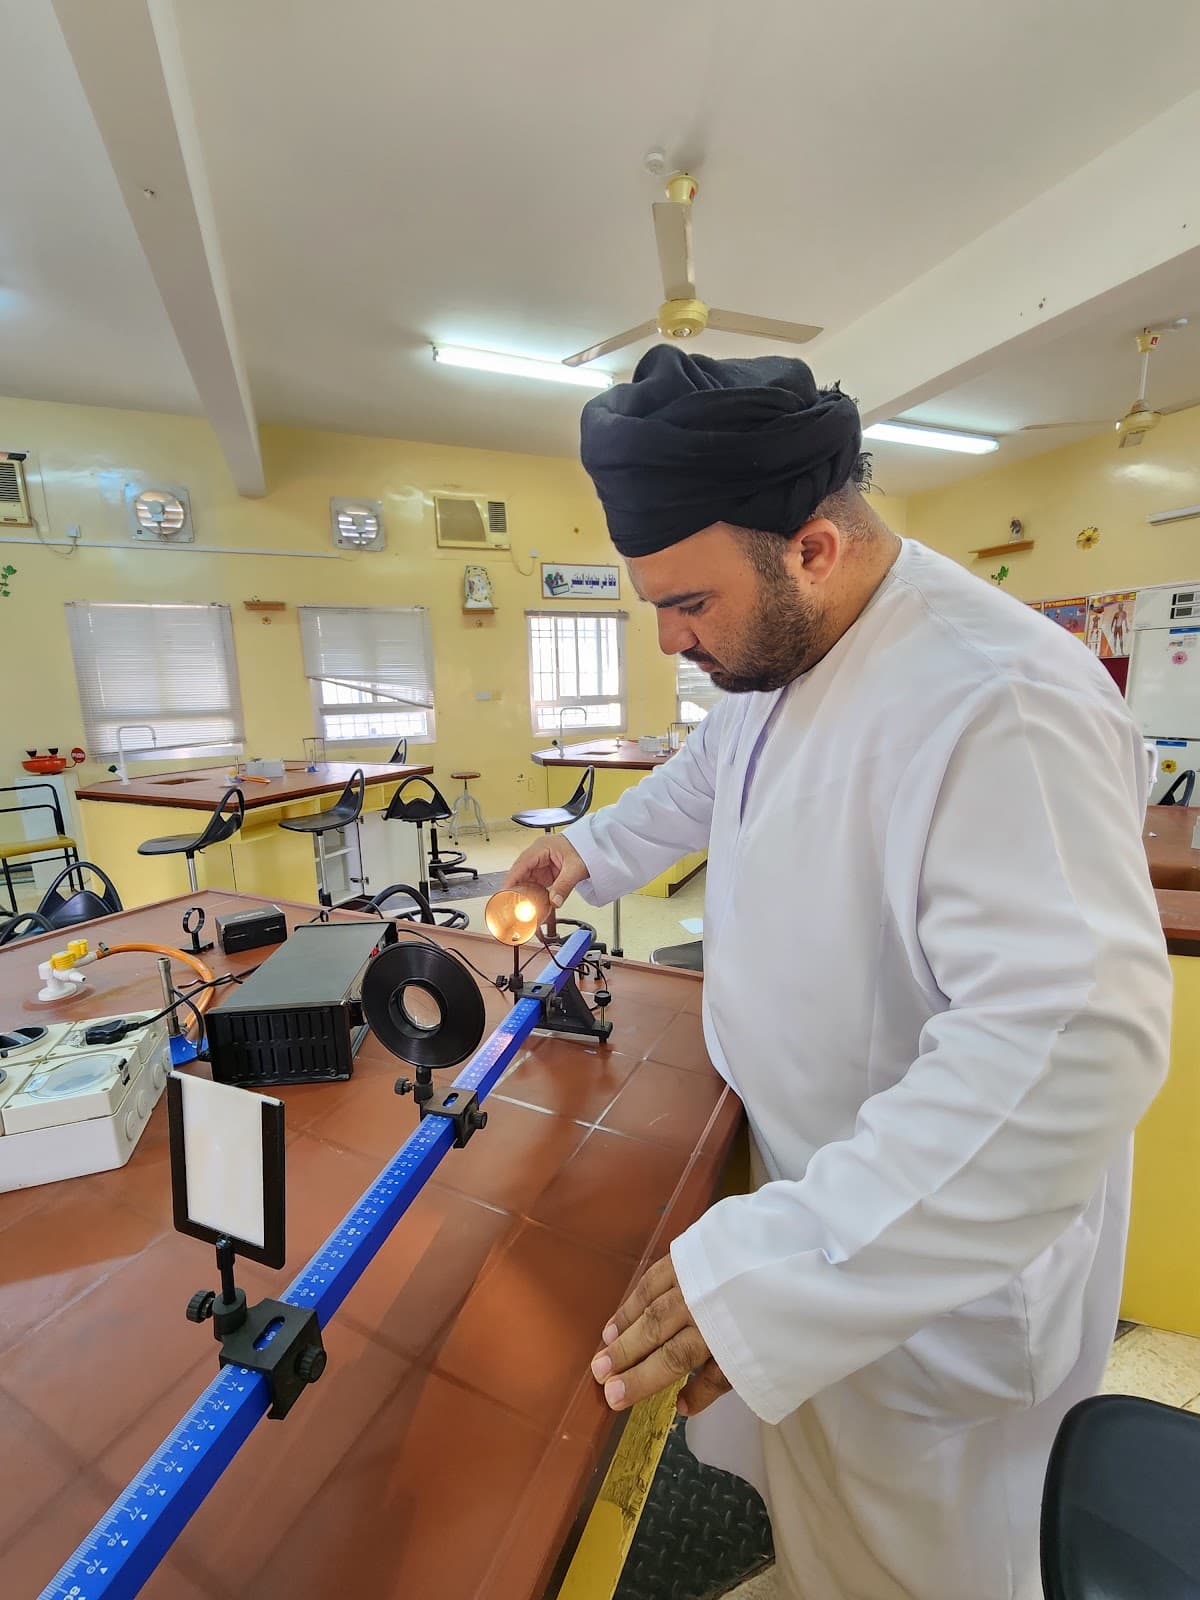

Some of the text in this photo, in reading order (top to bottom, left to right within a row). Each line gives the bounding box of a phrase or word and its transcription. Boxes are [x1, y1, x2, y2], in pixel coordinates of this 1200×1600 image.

[227, 1381, 238, 1391] 71
[212, 1400, 225, 1410] 72
[197, 1419, 209, 1430] 73
[181, 1439, 194, 1450] 74
[164, 1460, 177, 1472] 75
[146, 1483, 160, 1496] 76
[129, 1507, 142, 1520] 77
[107, 1532, 122, 1546] 78
[86, 1559, 102, 1574] 79
